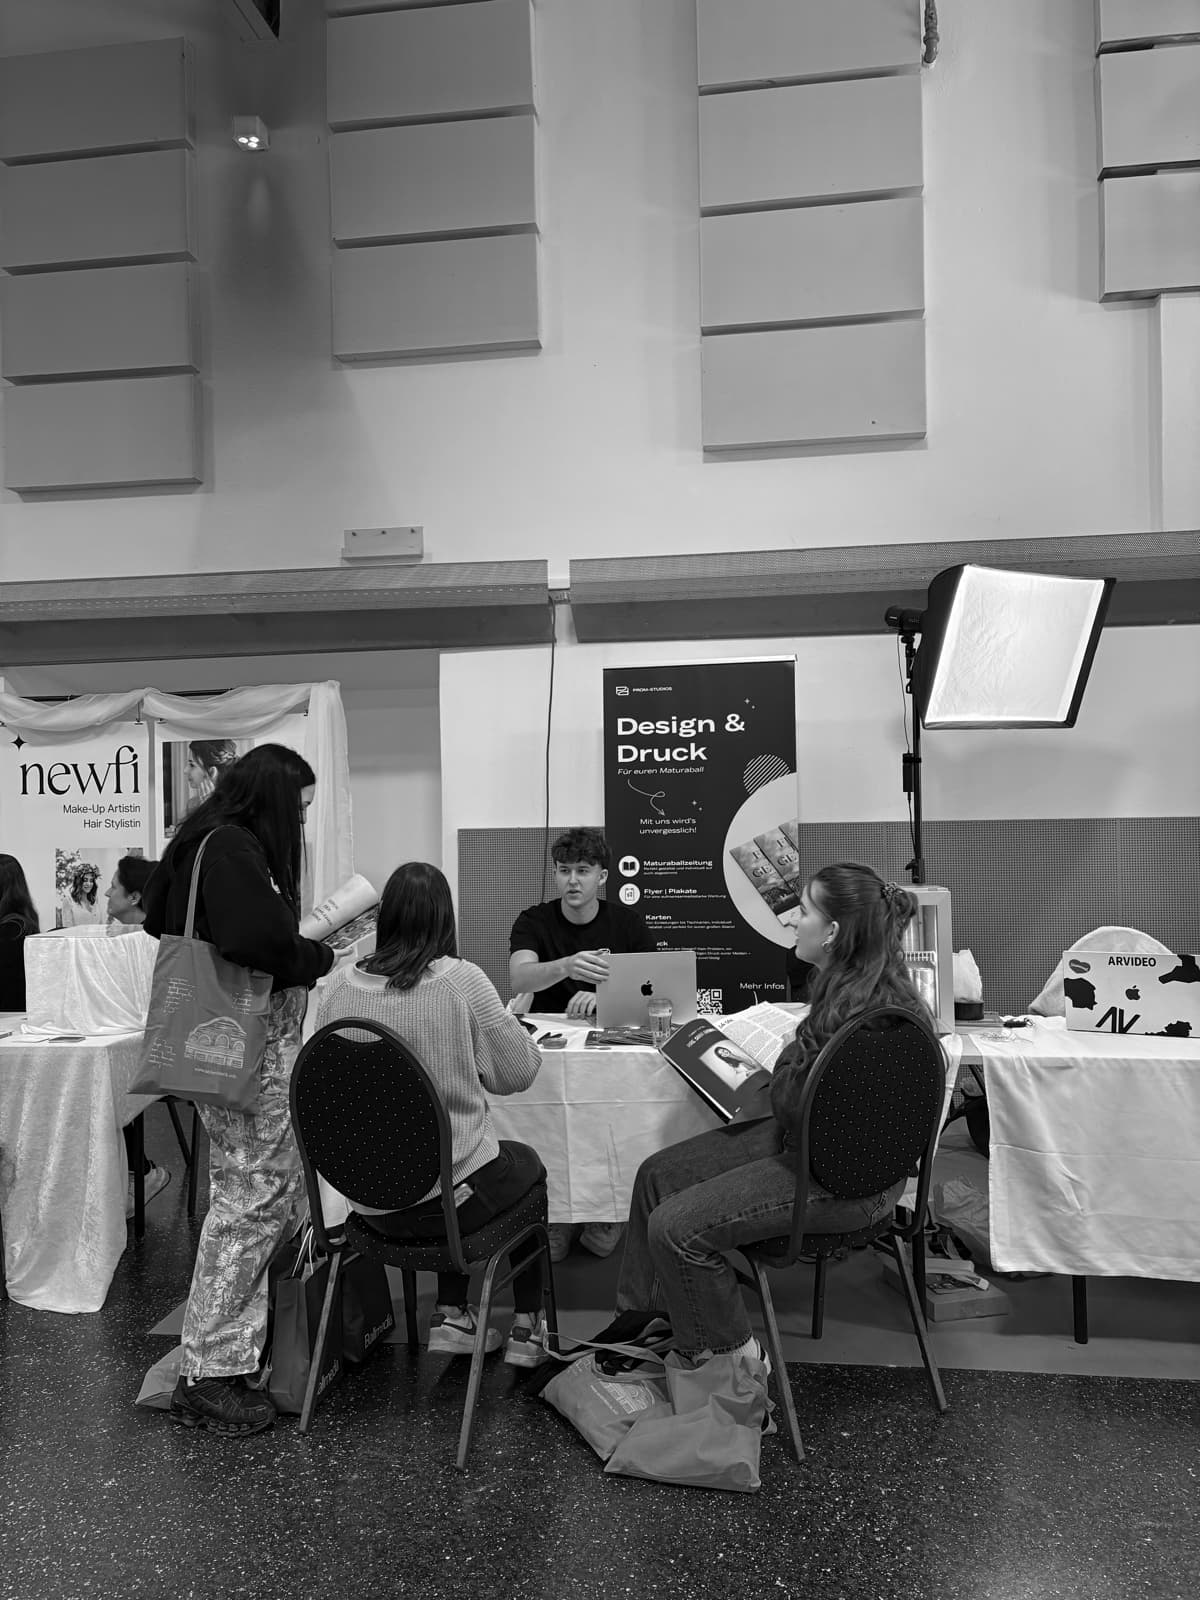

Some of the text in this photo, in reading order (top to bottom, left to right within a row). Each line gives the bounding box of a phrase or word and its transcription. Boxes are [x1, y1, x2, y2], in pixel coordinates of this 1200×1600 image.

[616, 713, 745, 738] Design &
[617, 742, 708, 763] Druck
[19, 745, 140, 796] newfi
[659, 766, 705, 775] Maturaball
[63, 803, 141, 816] Make-Up Artistin
[83, 818, 141, 830] Hair Stylistin
[672, 817, 697, 825] wird's
[639, 826, 697, 836] unvergesslich!
[643, 859, 713, 867] Maturaballzeitung
[668, 887, 698, 895] Plakate
[1107, 956, 1157, 967] ARVIDEO
[739, 982, 785, 990] Mehr Infos
